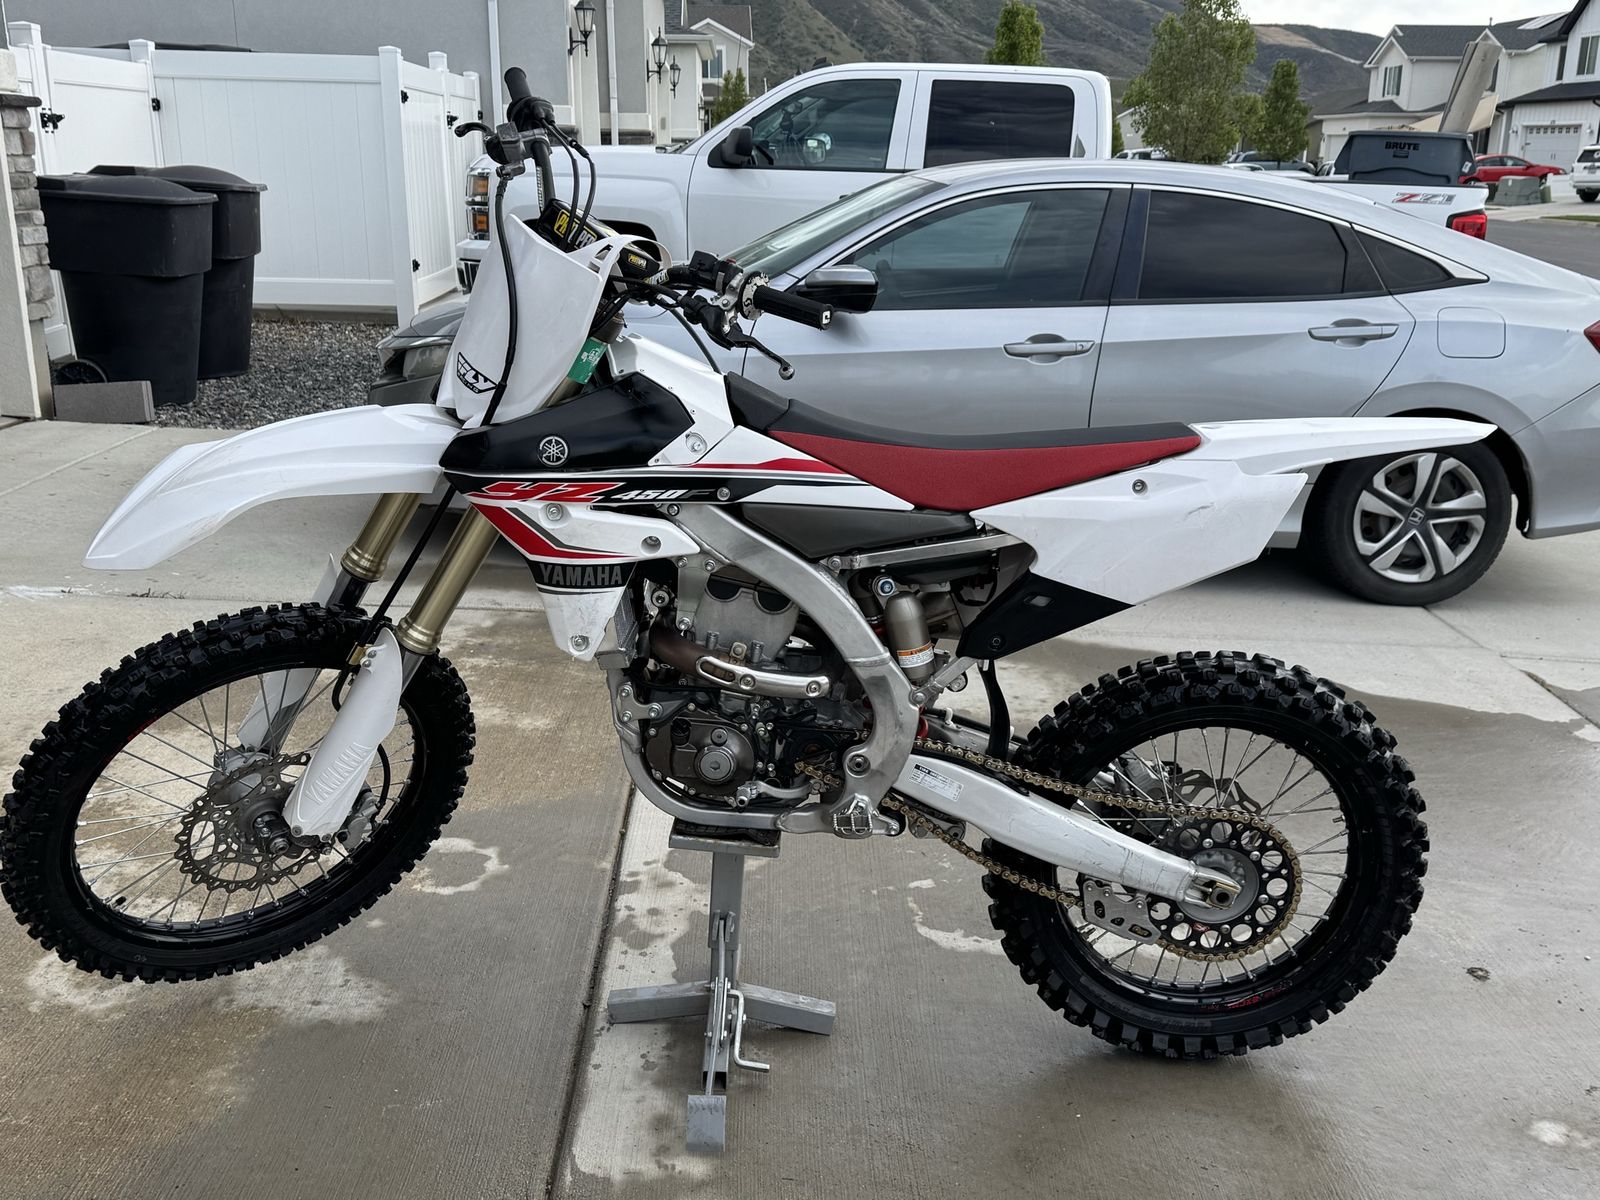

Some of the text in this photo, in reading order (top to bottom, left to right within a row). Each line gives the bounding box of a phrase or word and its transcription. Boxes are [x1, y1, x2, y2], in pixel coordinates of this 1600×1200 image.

[1385, 141, 1420, 150] BRUTE
[458, 354, 496, 391] FLY
[468, 481, 715, 503] YZ 450F
[540, 564, 623, 587] YAMAHA
[304, 741, 373, 806] YAMAHA
